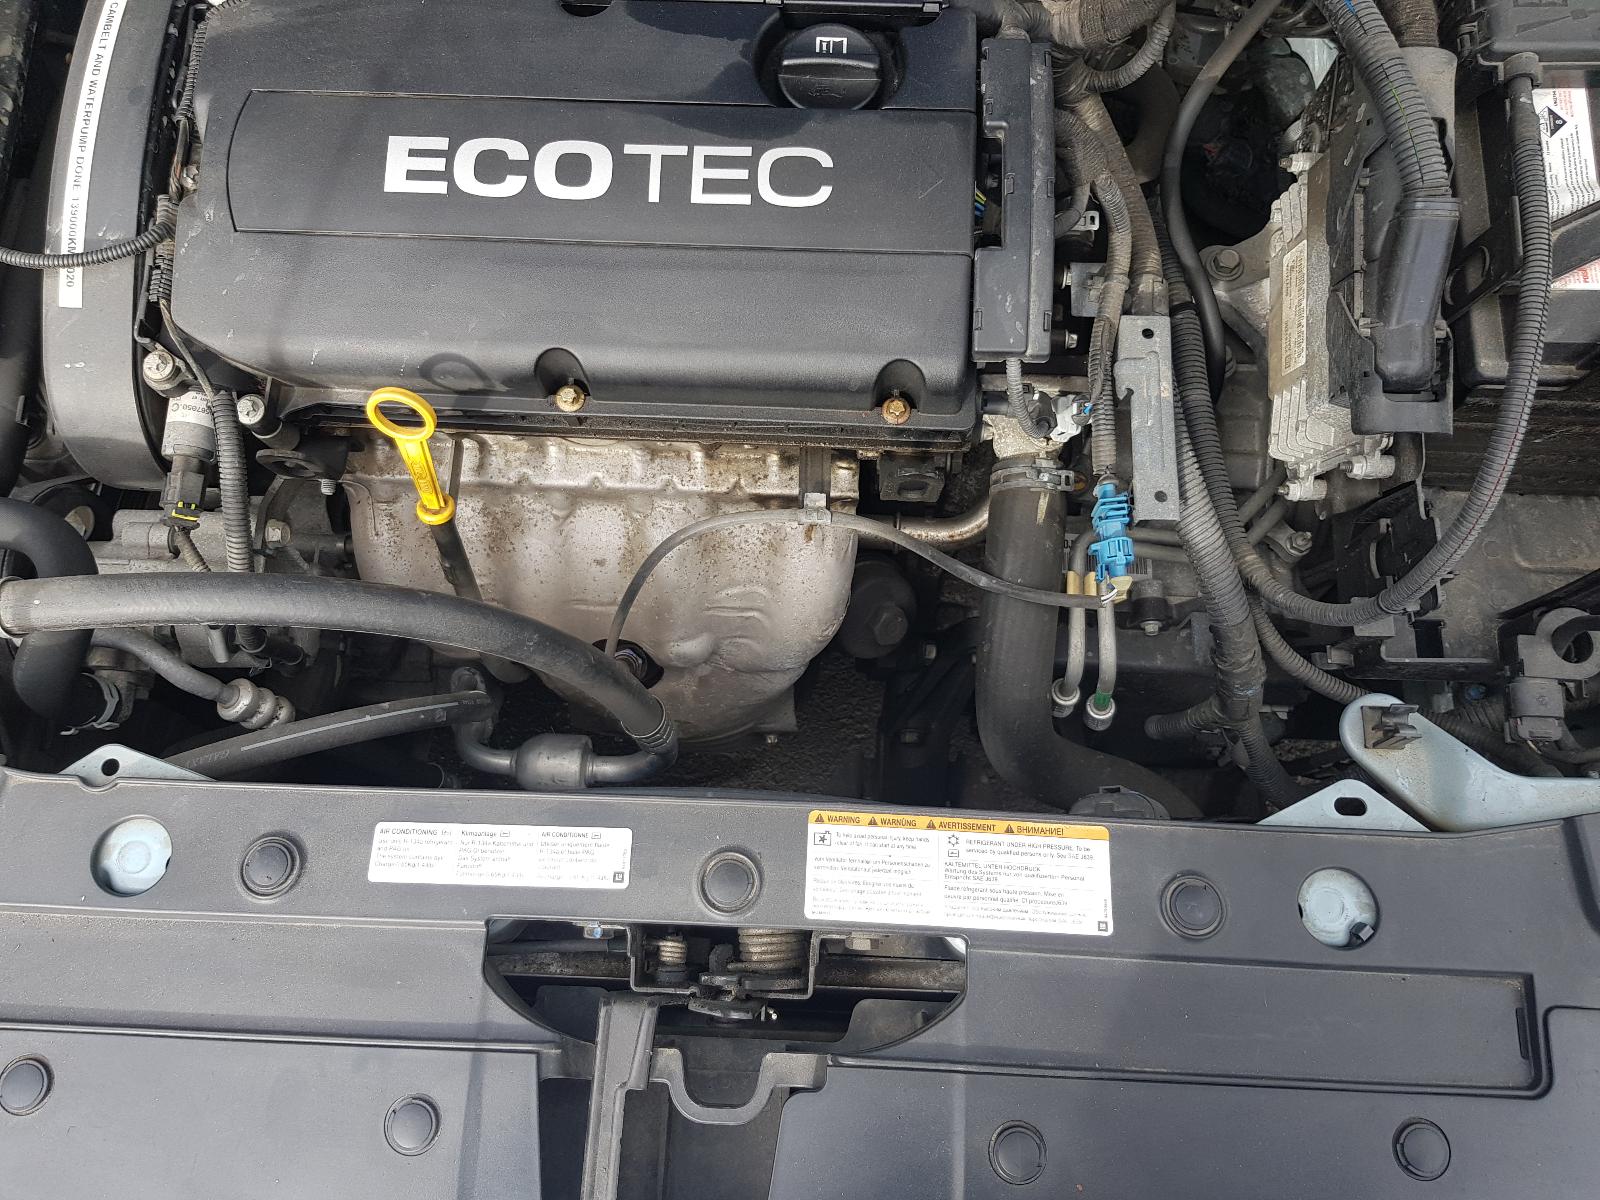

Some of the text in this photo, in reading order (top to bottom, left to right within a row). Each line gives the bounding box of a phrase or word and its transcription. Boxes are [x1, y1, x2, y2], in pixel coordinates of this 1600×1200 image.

[95, 1, 118, 51] CAMBELT
[91, 53, 103, 76] AND
[76, 79, 98, 153] WATERPUMP
[72, 156, 85, 191] DONE
[384, 135, 834, 208] ECOTEC
[65, 268, 76, 288] 020
[827, 815, 860, 824] WARNING
[938, 821, 996, 832] AVERTISSEMENT
[391, 828, 438, 836] CONDITIONING
